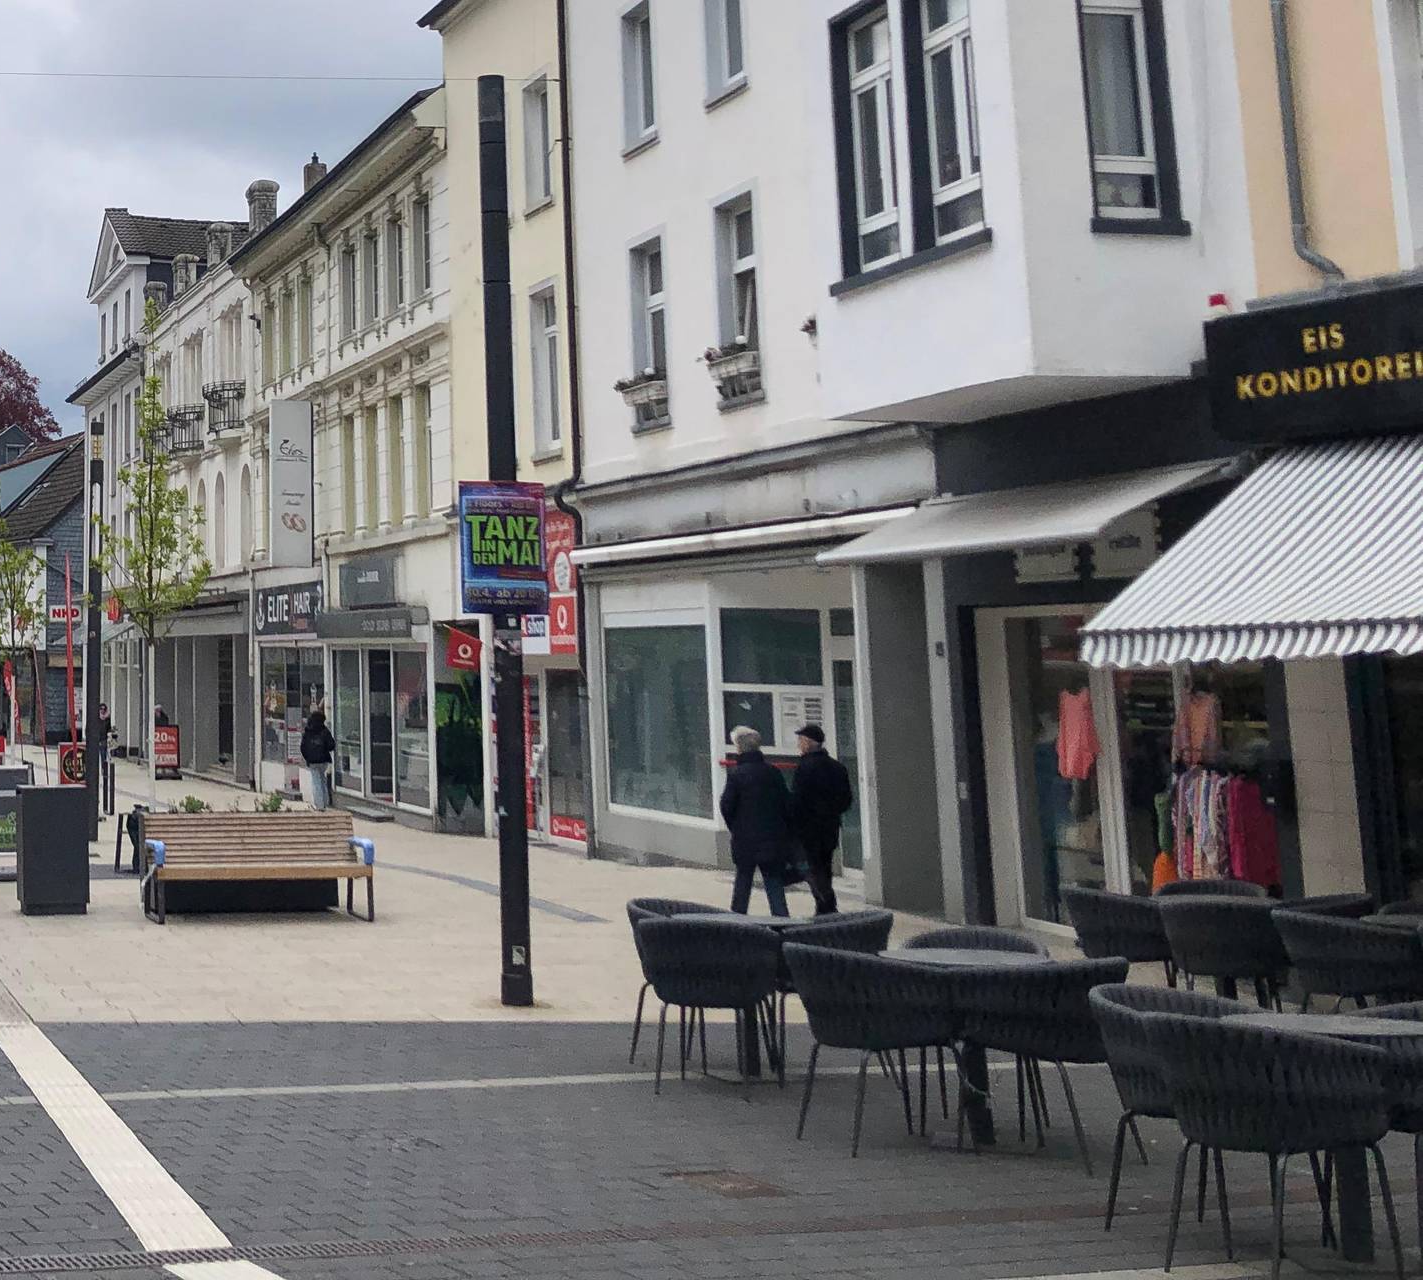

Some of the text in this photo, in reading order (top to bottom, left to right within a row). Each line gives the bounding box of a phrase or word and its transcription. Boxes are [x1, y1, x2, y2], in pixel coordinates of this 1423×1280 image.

[1301, 323, 1345, 353] EIS
[465, 515, 540, 552] TANZ
[481, 541, 496, 552] IN
[473, 552, 497, 565] DEN
[498, 541, 541, 566] MAI
[267, 591, 311, 623] ELITE HAIR
